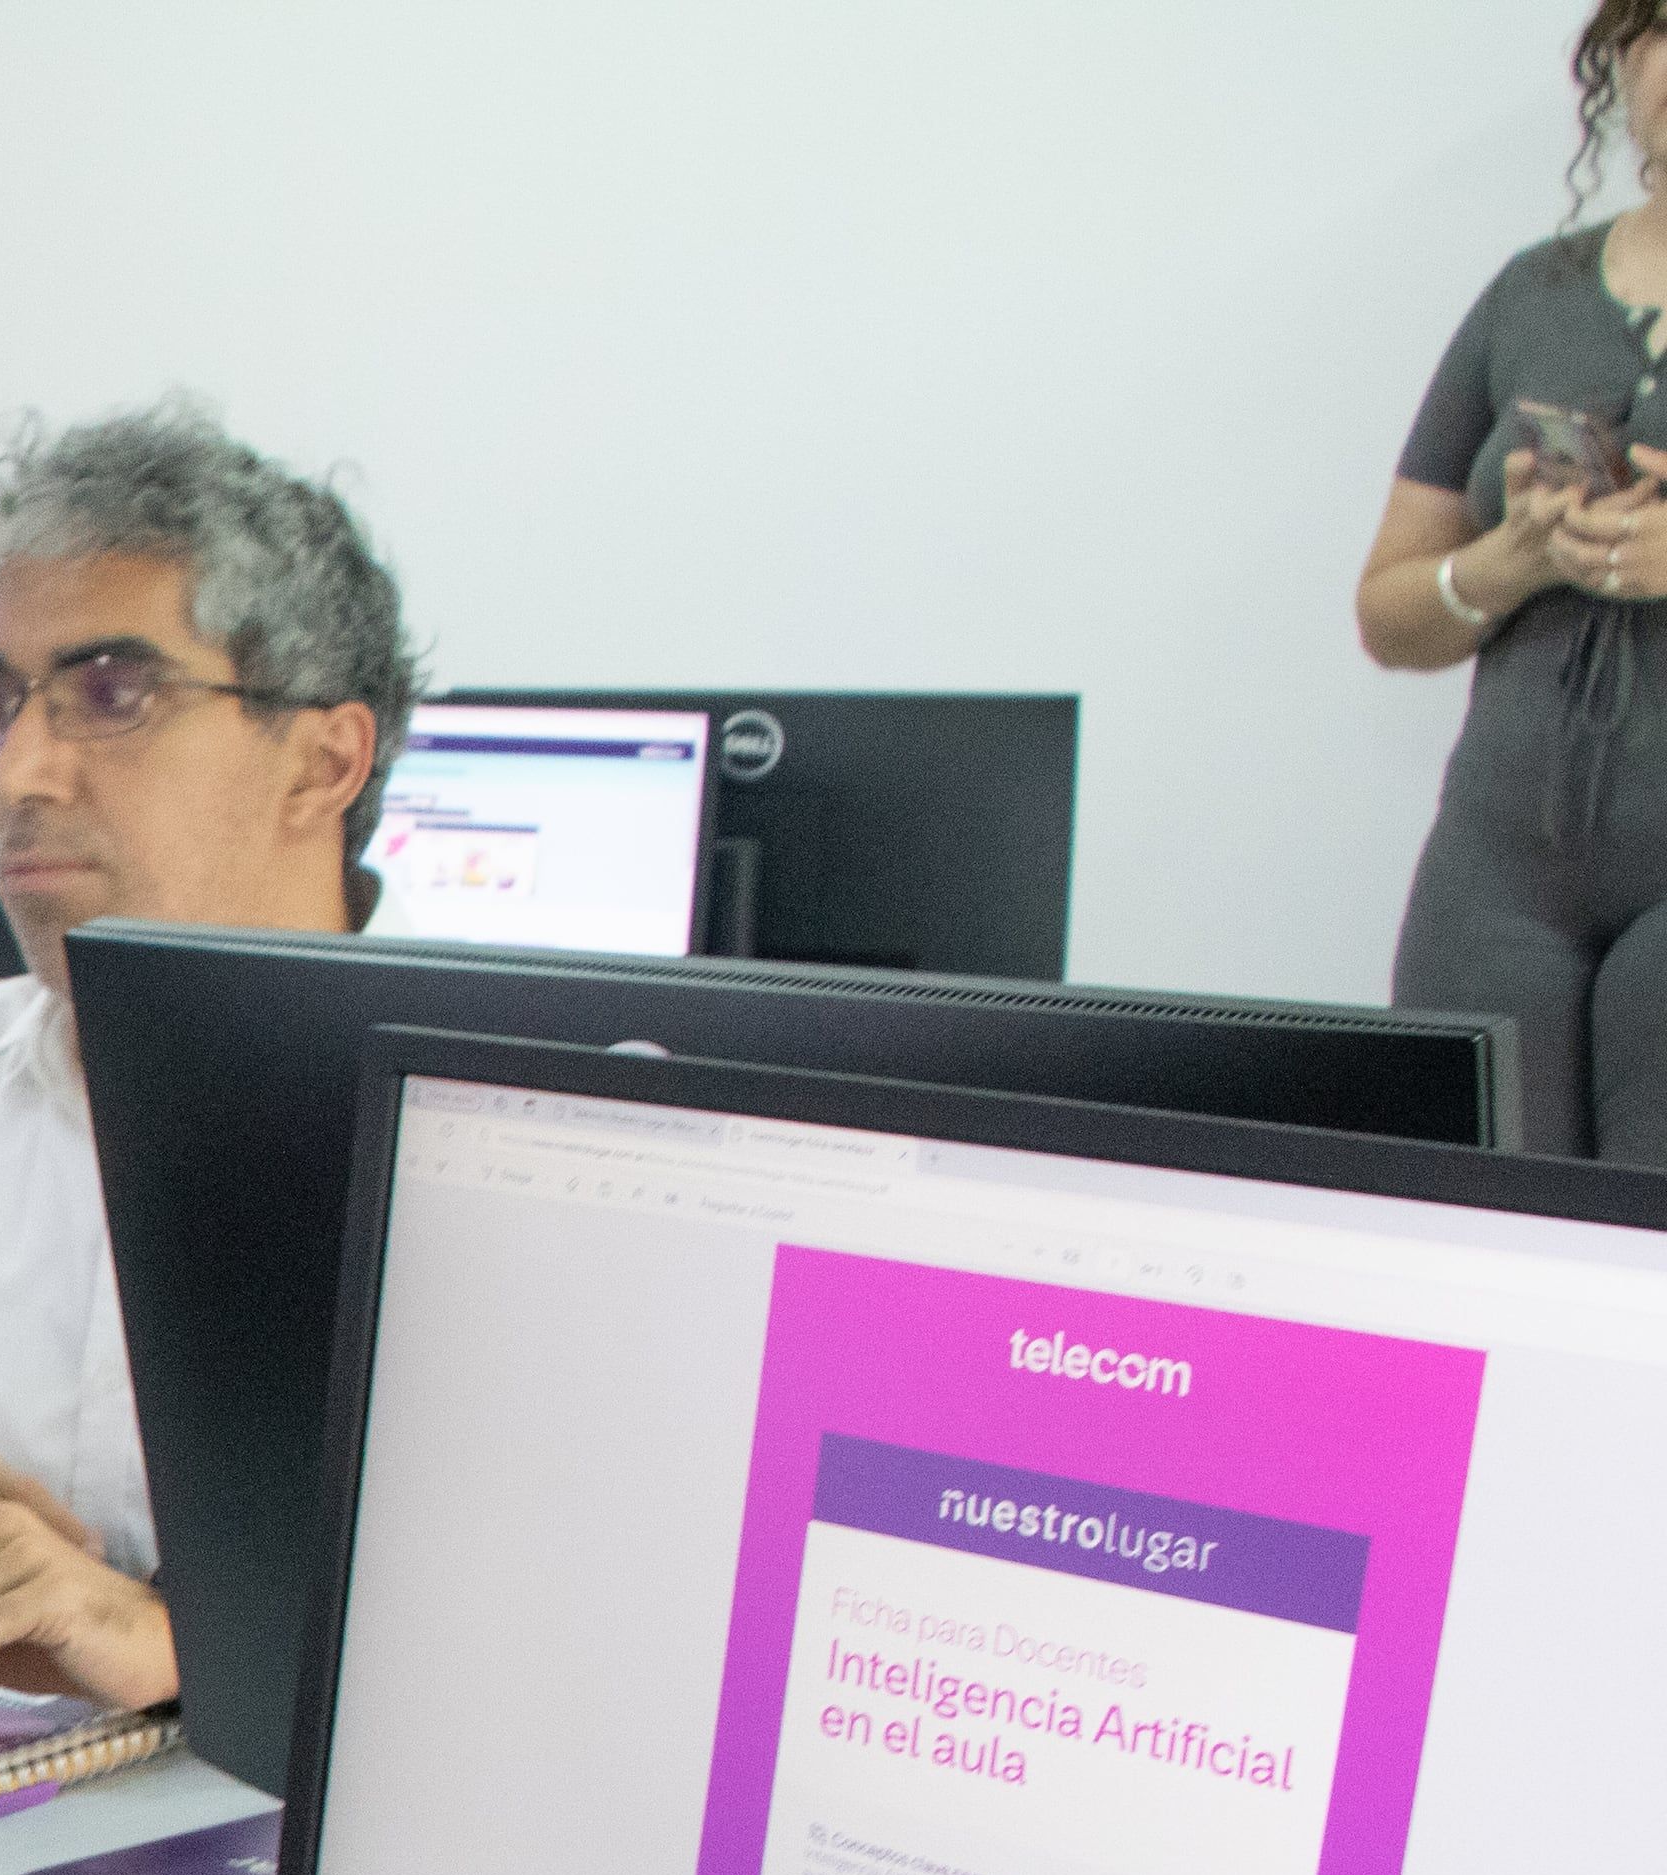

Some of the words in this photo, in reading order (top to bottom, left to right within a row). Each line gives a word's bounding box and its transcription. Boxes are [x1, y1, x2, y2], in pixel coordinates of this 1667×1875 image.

[1008, 1327, 1193, 1398] telecom
[938, 1487, 1220, 1573] nuestrolugar
[830, 1585, 911, 1635] Ficha
[916, 1614, 986, 1654] para
[991, 1623, 1149, 1690] Docentes
[819, 1702, 873, 1746] en
[882, 1715, 923, 1758] el
[931, 1731, 1028, 1786] aula
[826, 1637, 1083, 1738] Inteligencia
[1092, 1704, 1296, 1791] Artificial
